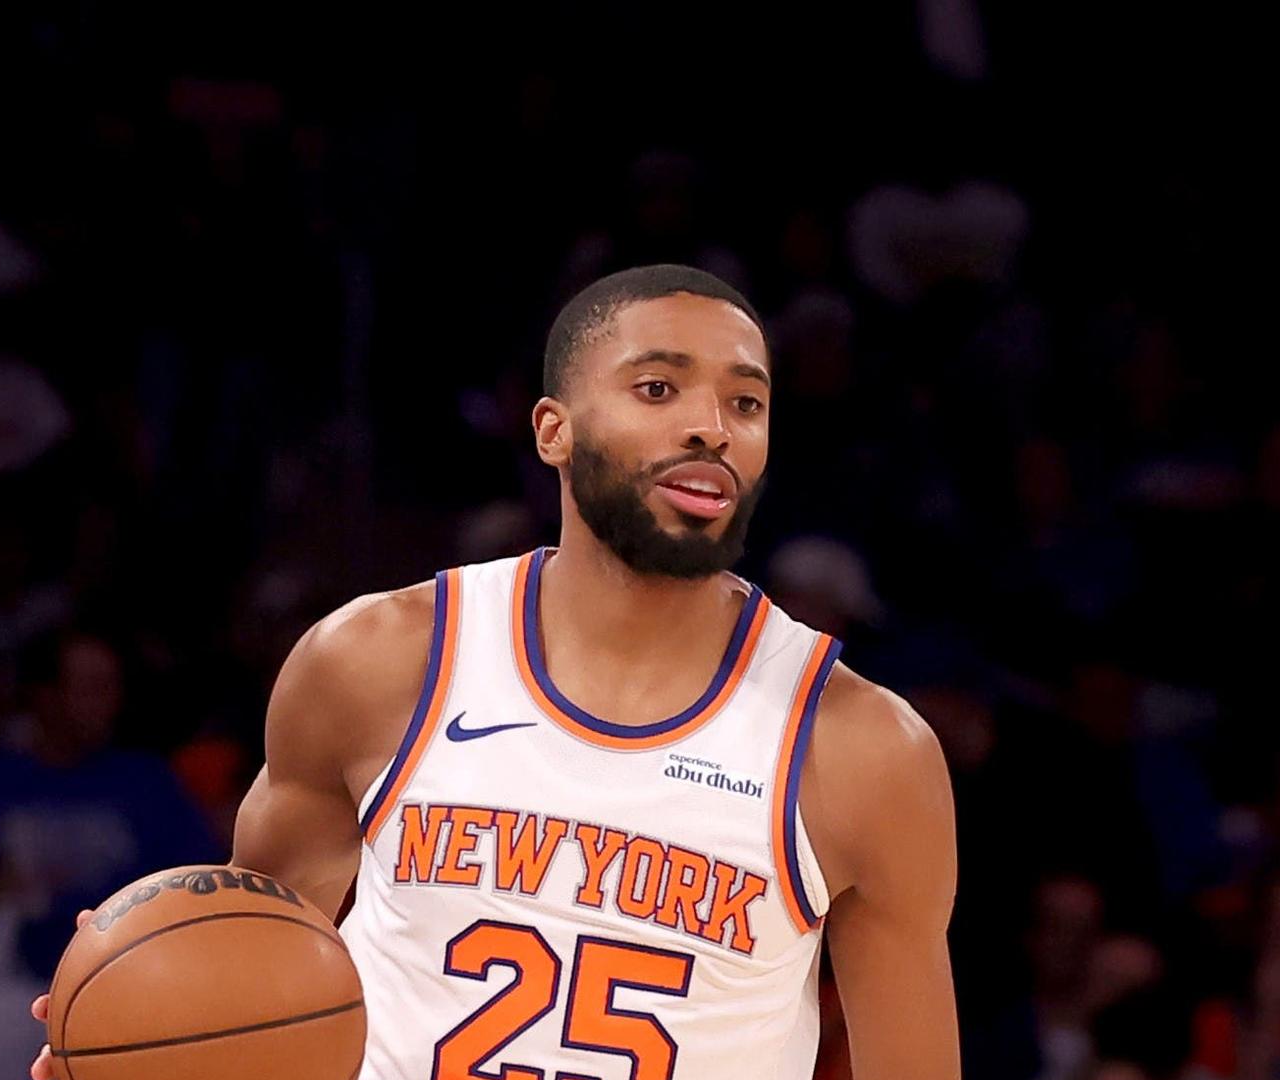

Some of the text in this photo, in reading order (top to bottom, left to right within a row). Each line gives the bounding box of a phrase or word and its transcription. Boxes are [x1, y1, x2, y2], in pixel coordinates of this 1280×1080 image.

[668, 753, 722, 771] experience
[664, 764, 764, 798] abu dhabi
[394, 803, 767, 954] NEW YORK
